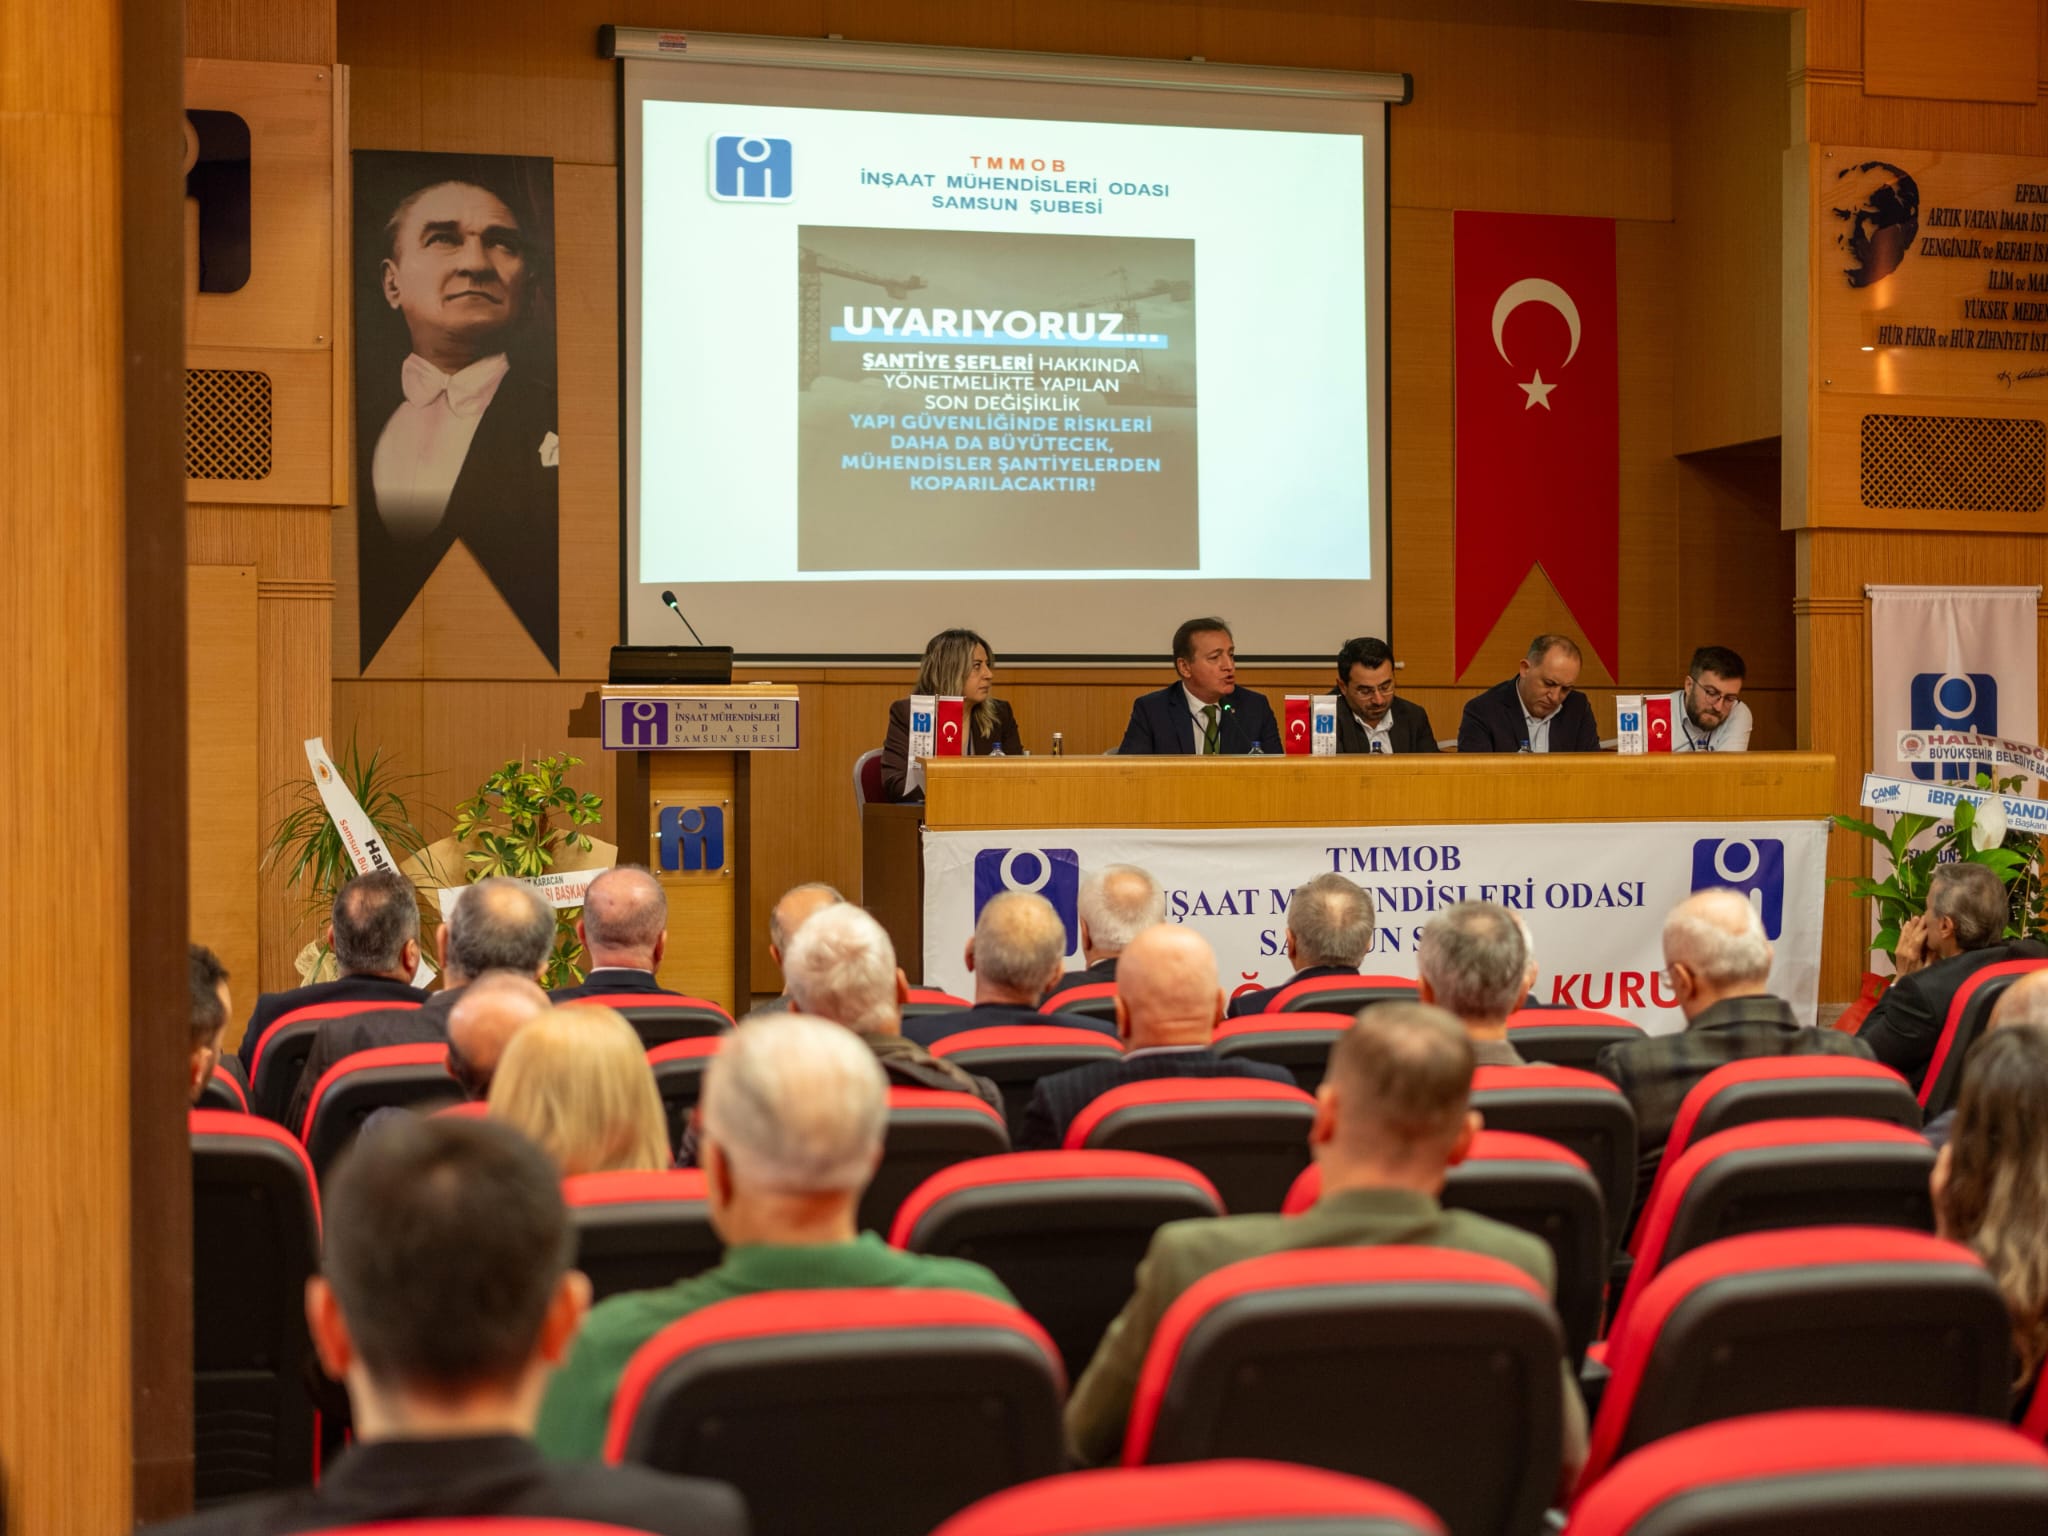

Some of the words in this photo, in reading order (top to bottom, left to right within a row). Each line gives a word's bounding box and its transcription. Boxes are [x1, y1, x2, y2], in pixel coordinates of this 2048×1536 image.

[969, 156, 1066, 173] TMMOB
[860, 167, 936, 189] İNŞAAT
[946, 173, 1098, 195] MÜHENDİSLERİ
[1108, 182, 1170, 198] ODASI
[2015, 183, 2048, 204] EFEN
[931, 195, 1019, 212] SAMSUN
[1029, 198, 1104, 215] ŞUBESİ
[1927, 207, 1962, 227] ARTIK
[1964, 209, 1999, 230] VATAN
[2000, 209, 2029, 232] İMAR
[2030, 211, 2048, 233] İST
[1920, 236, 1981, 259] ZENGİNLİK
[1995, 240, 2032, 261] REFAH
[1988, 268, 2014, 291] İLİM
[1964, 299, 2009, 320] YÜKSEK
[843, 305, 1159, 343] UYARIYORUZ...
[1878, 324, 1903, 346] HÜR
[1905, 324, 1936, 347] FİKİR
[1950, 327, 1975, 349] HÜR
[1976, 327, 2029, 351] ZİHNİYET
[2030, 330, 2048, 352] İST
[862, 351, 950, 371] ŞANTİYE
[954, 353, 1034, 373] ŞEFLERİ
[1039, 357, 1140, 374] HAKKINDA
[883, 371, 1035, 391] YÖNETMELİKTE
[1040, 377, 1120, 393] YAPILAN
[924, 395, 968, 410] SON
[974, 393, 1081, 414] DEĞİŞİKLİK
[849, 414, 896, 429] YAPI
[901, 412, 1059, 431] GÜVENLİĞİNDE
[1063, 414, 1153, 433] RİSKLERİ
[890, 435, 949, 450] DAHA
[954, 435, 983, 450] DA
[988, 433, 1114, 453] BÜYÜTECEK,
[841, 452, 992, 471] MÜHENDİSLER
[998, 454, 1162, 474] ŞANTİYELERDEN
[909, 476, 1096, 492] KOPARILACAKTIR!
[675, 702, 780, 711] TMMOB
[674, 724, 780, 733] ODASI
[675, 712, 708, 724] İNŞAAT
[710, 712, 780, 722] MÜHENDİSLERİ
[674, 734, 727, 743] SAMSUN
[735, 733, 780, 744] ŞUBESİ
[1929, 745, 1993, 761] BÜYÜKŞEHİR
[1996, 750, 2036, 772] BELEDİYE
[2015, 817, 2047, 831] Başkanı
[339, 818, 361, 857] Samsun
[1325, 845, 1461, 873] TMMOB
[533, 875, 564, 887] KARACAN
[555, 882, 588, 904] BAŞKAN
[1163, 888, 1260, 923] ŞAAT
[1544, 880, 1647, 909] ODASI
[1551, 971, 1681, 1009] KURU
